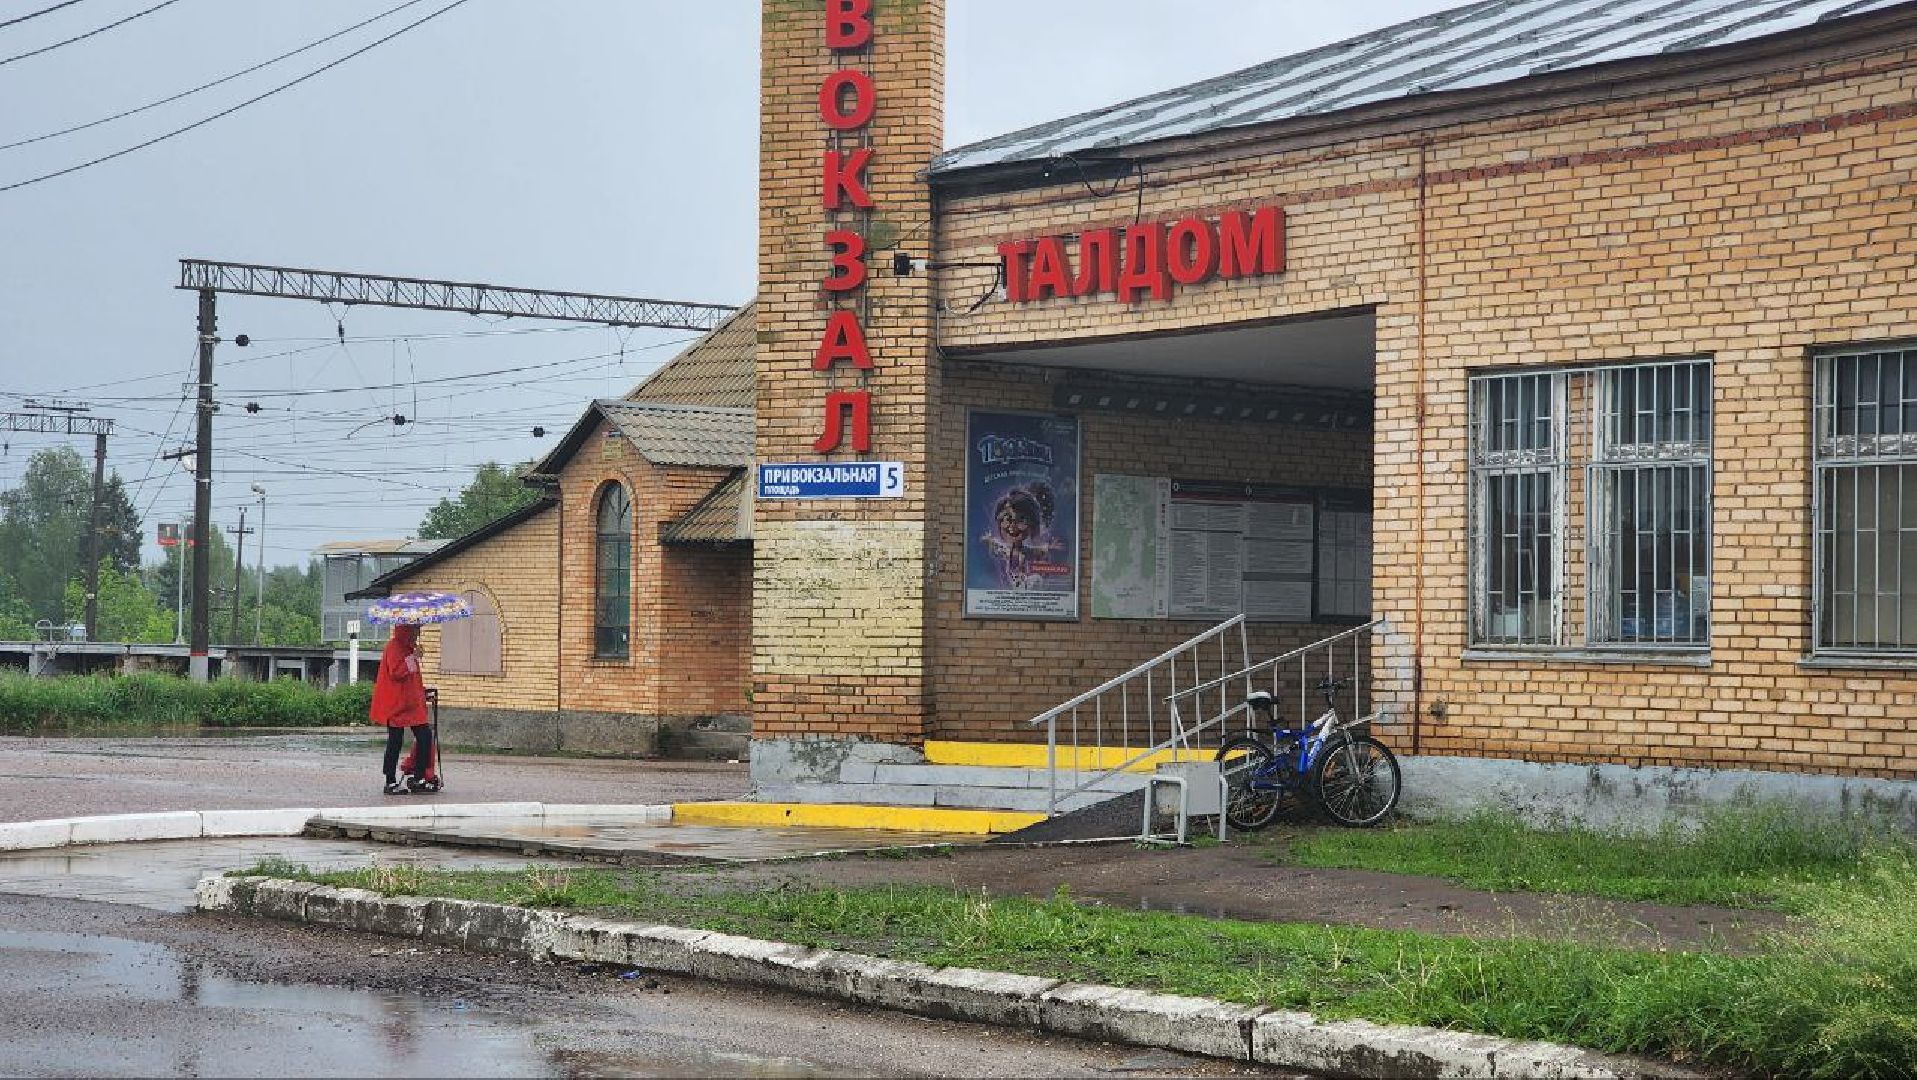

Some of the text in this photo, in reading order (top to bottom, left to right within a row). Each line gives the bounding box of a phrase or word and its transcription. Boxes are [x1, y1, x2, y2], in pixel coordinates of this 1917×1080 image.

[813, 0, 876, 453] ВОКЗАЛ
[997, 206, 1286, 304] ТАЛДОМ
[764, 467, 899, 489] ПРИВОКЗАЛЬНАЯ 5
[764, 485, 800, 496] ПЛОЩАДЬ
